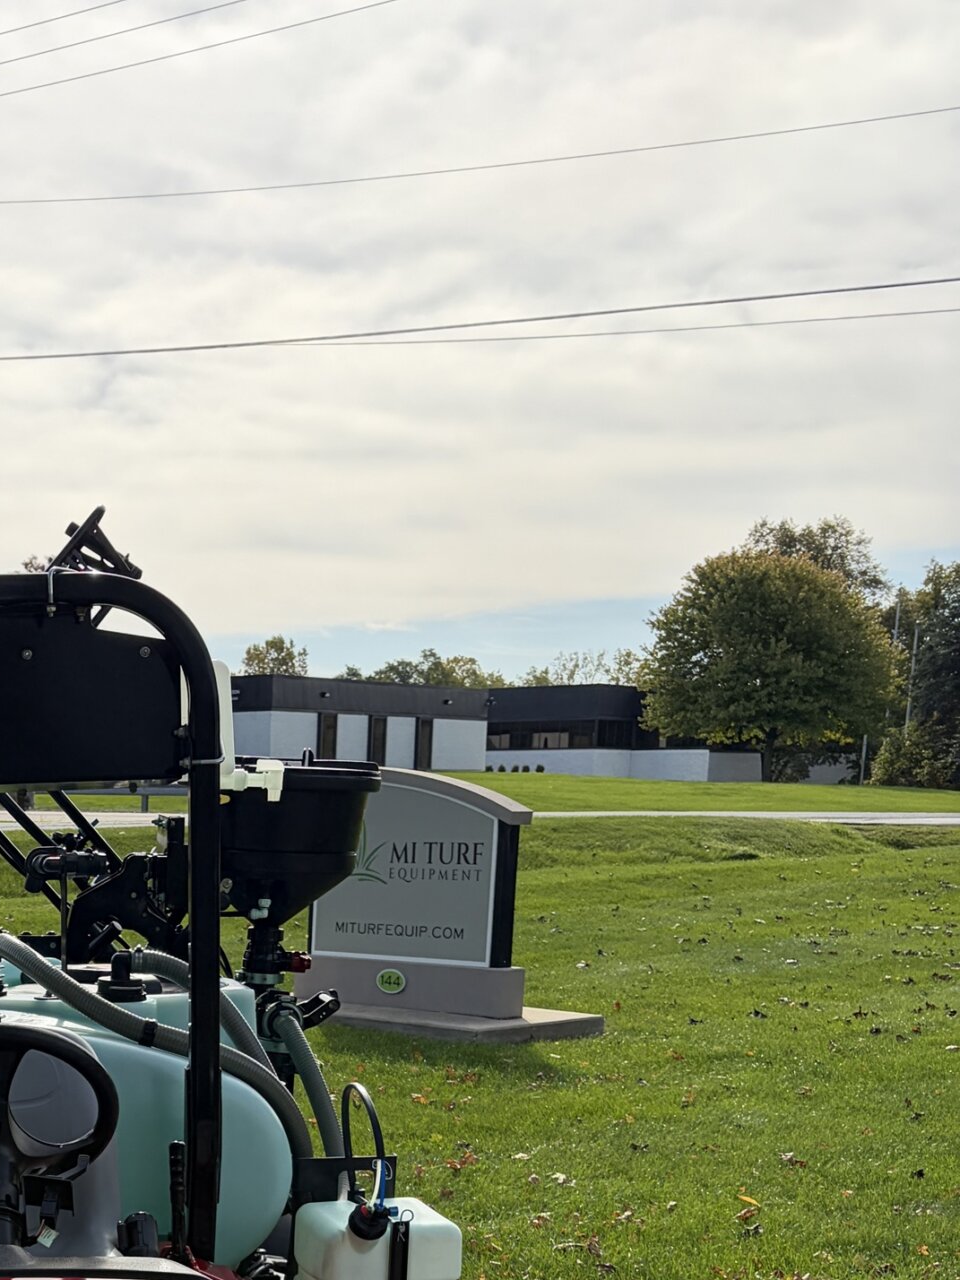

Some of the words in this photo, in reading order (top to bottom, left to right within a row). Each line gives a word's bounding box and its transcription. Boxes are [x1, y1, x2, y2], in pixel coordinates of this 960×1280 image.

[389, 842, 417, 864] MI
[423, 842, 485, 865] TURF
[388, 867, 483, 883] EQUIPMENT
[334, 921, 465, 940] MITURFEQUIP.COM
[379, 974, 402, 988] 144
